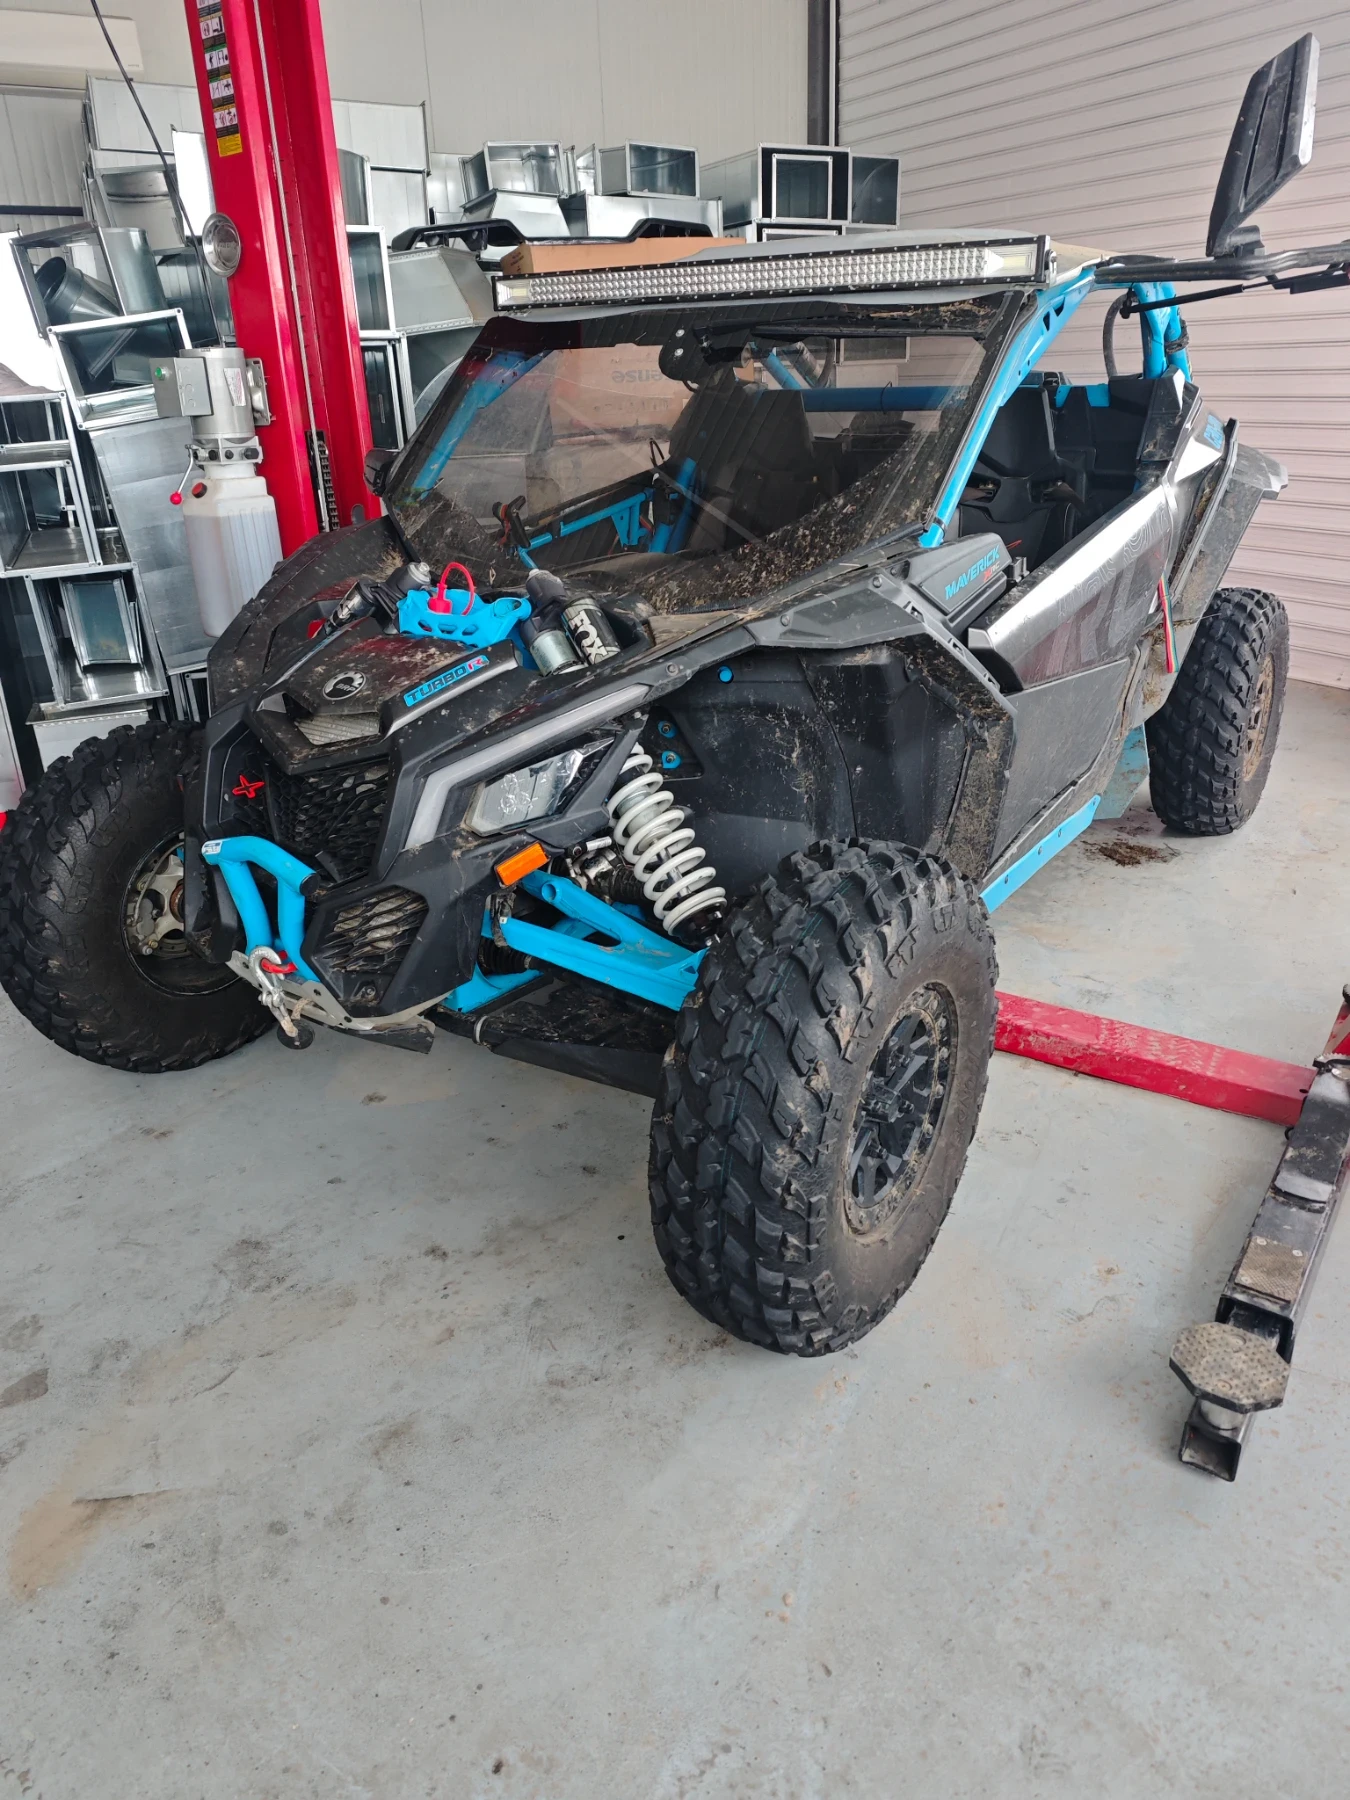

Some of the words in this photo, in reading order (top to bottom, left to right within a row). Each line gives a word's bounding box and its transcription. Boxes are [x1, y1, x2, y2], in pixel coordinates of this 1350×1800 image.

[611, 369, 666, 384] ense
[945, 544, 1000, 600] MAVERICK
[568, 609, 609, 665] FOX
[335, 683, 356, 692] BRP
